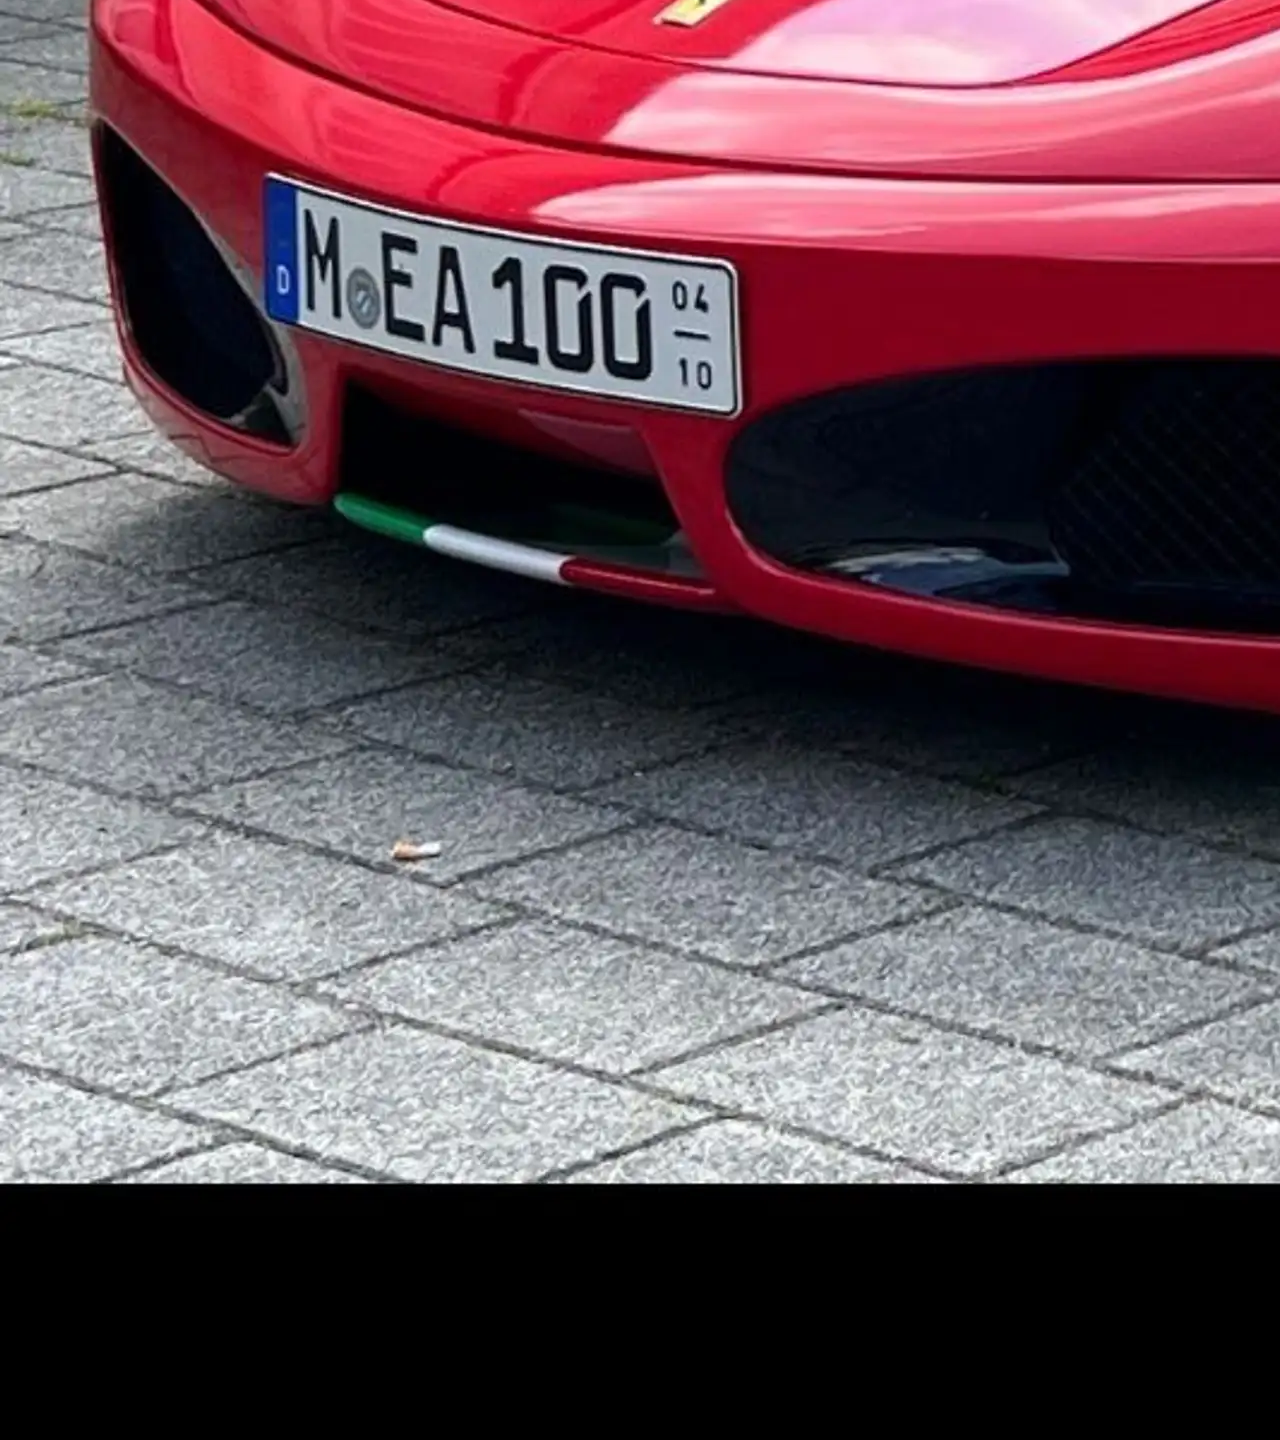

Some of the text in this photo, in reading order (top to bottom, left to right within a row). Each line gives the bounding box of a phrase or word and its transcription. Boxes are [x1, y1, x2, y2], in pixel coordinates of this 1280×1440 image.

[275, 267, 290, 295] D
[671, 280, 710, 313] 04
[678, 358, 712, 390] 10
